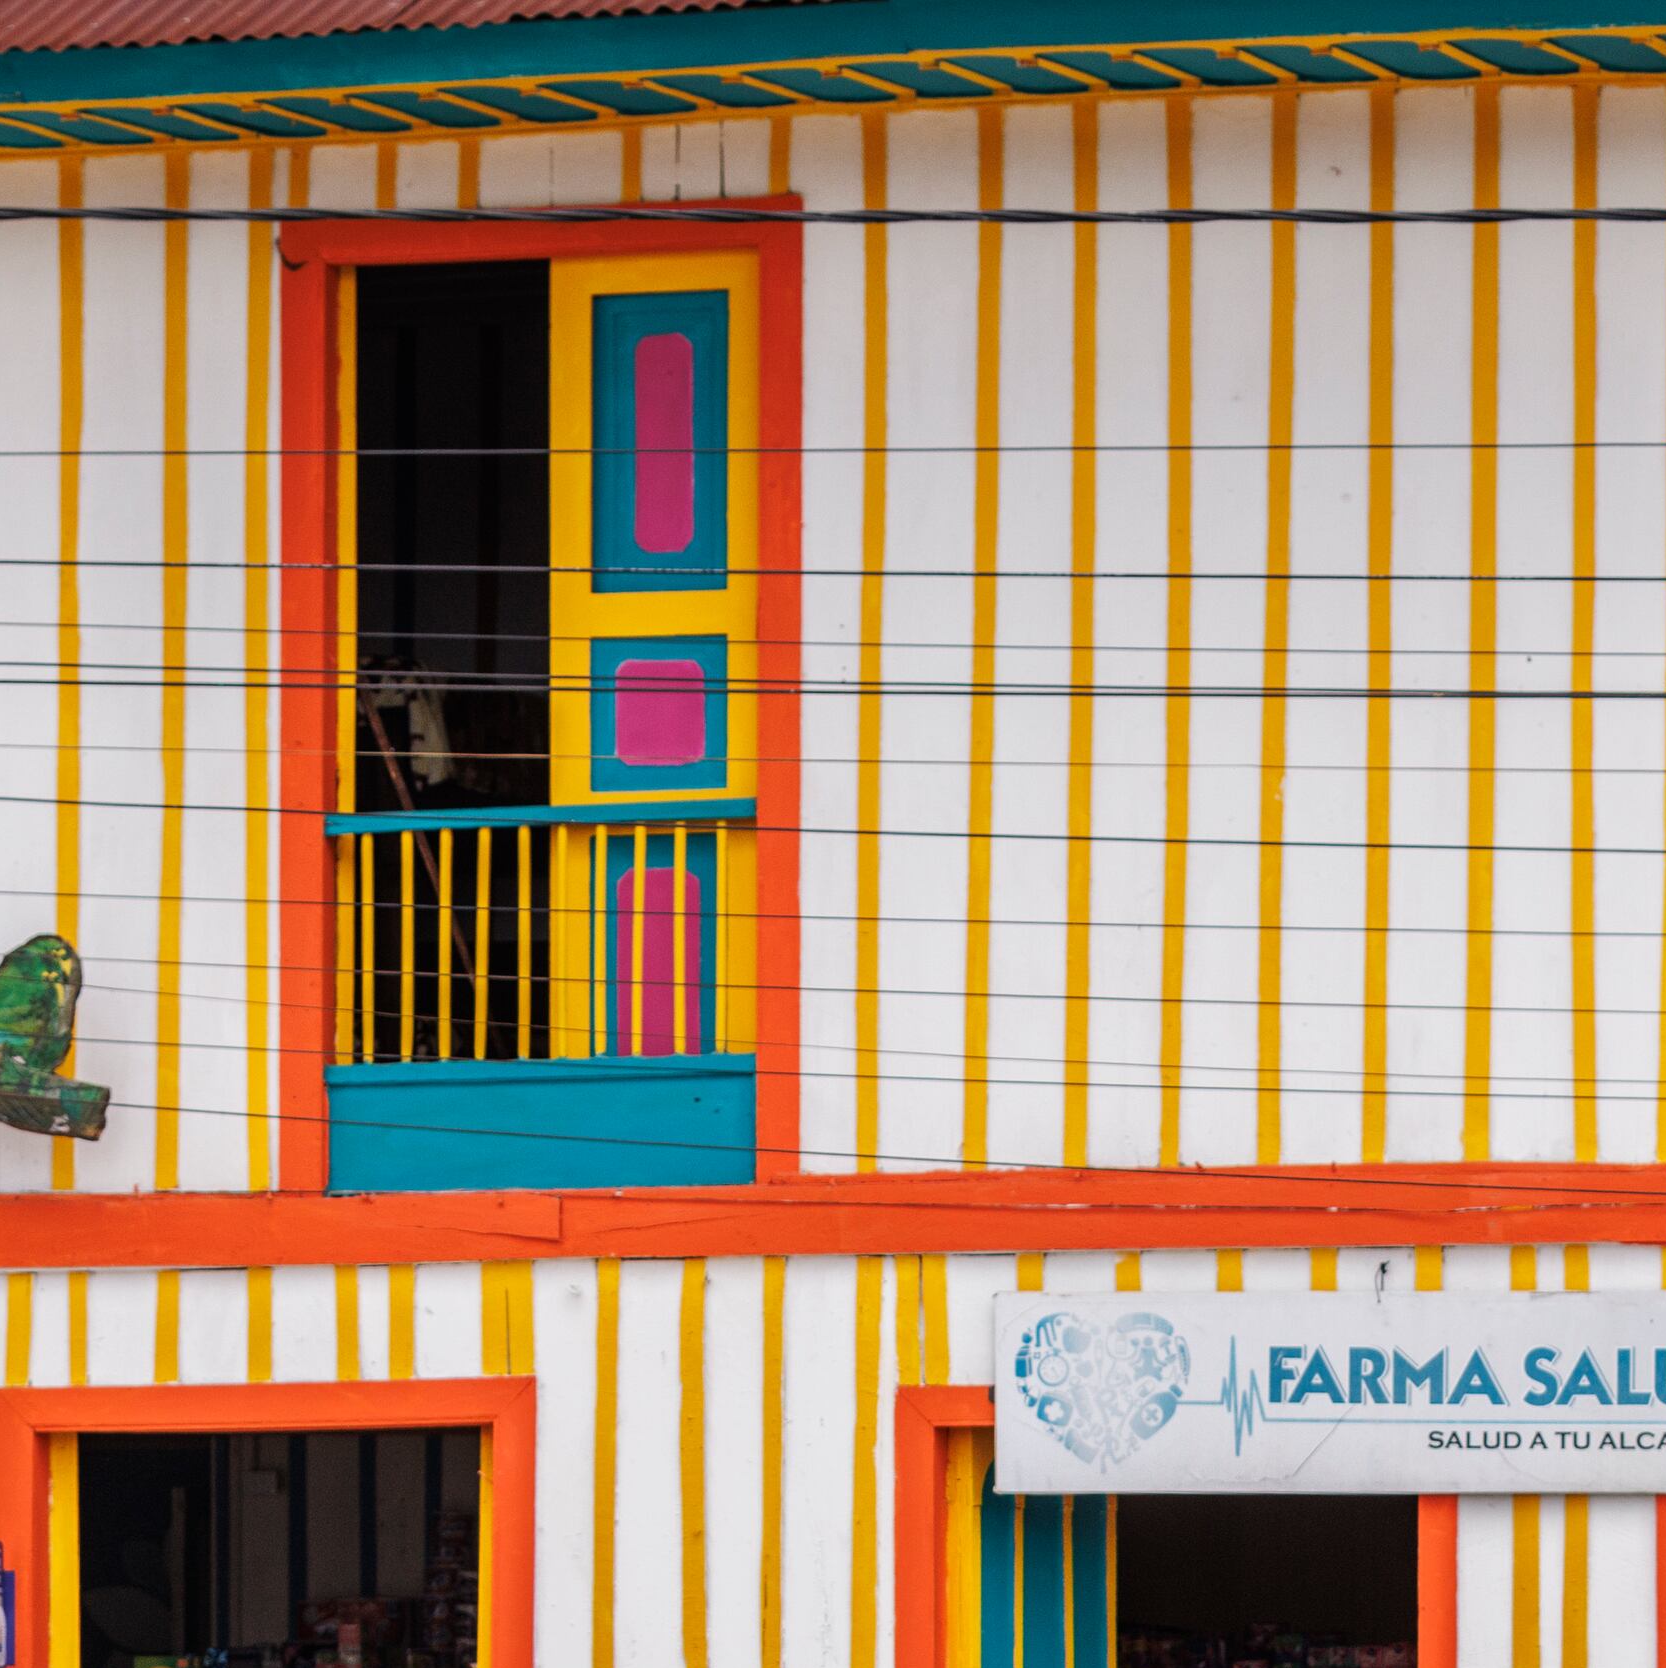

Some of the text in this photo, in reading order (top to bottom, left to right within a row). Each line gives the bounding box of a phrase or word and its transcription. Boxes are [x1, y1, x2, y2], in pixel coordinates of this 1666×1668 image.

[1268, 1345, 1508, 1406] FARMA
[1428, 1431, 1522, 1450] SALUD
[1528, 1431, 1549, 1450] A
[1555, 1431, 1591, 1450] TU
